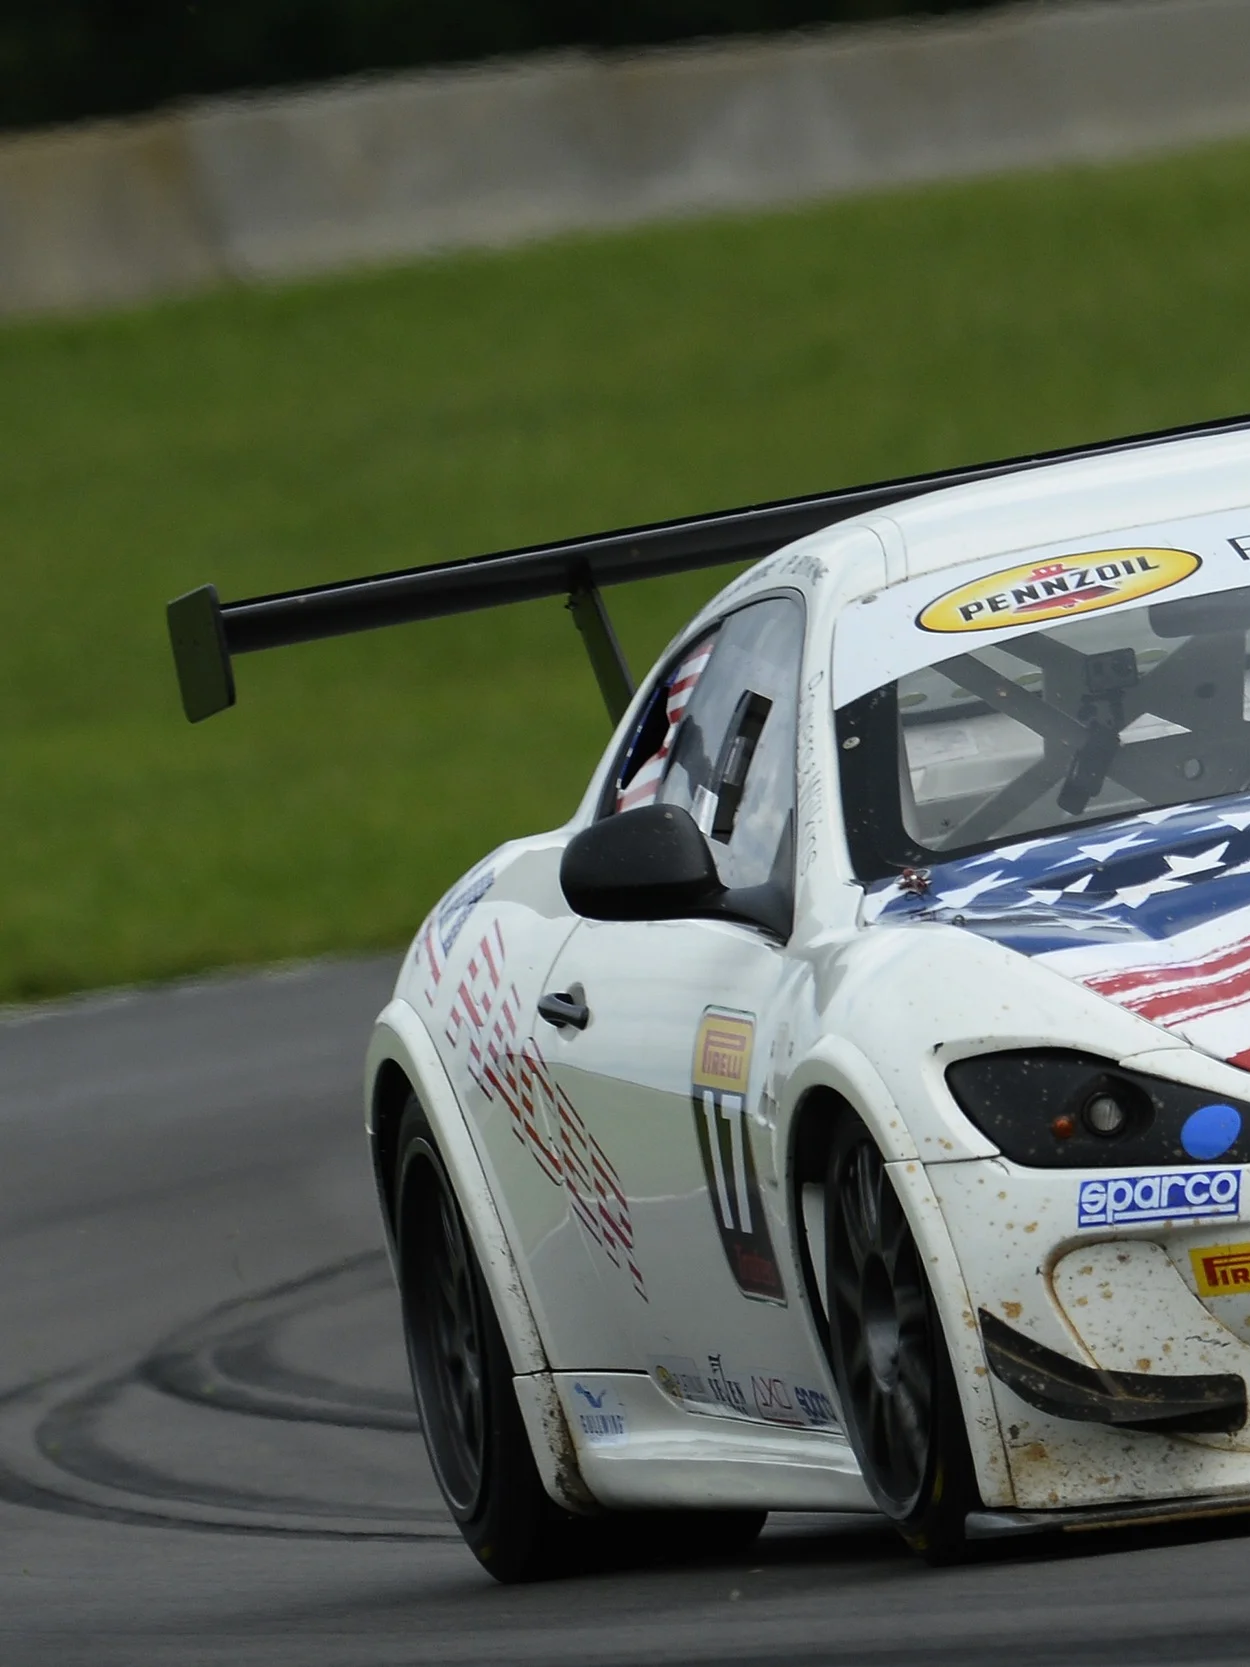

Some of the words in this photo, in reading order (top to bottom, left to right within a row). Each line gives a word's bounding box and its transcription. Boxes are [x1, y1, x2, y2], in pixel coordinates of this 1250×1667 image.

[957, 555, 1160, 622] PENNZOIL
[702, 1030, 747, 1080] PIRELLI
[1079, 1171, 1239, 1223] sparco
